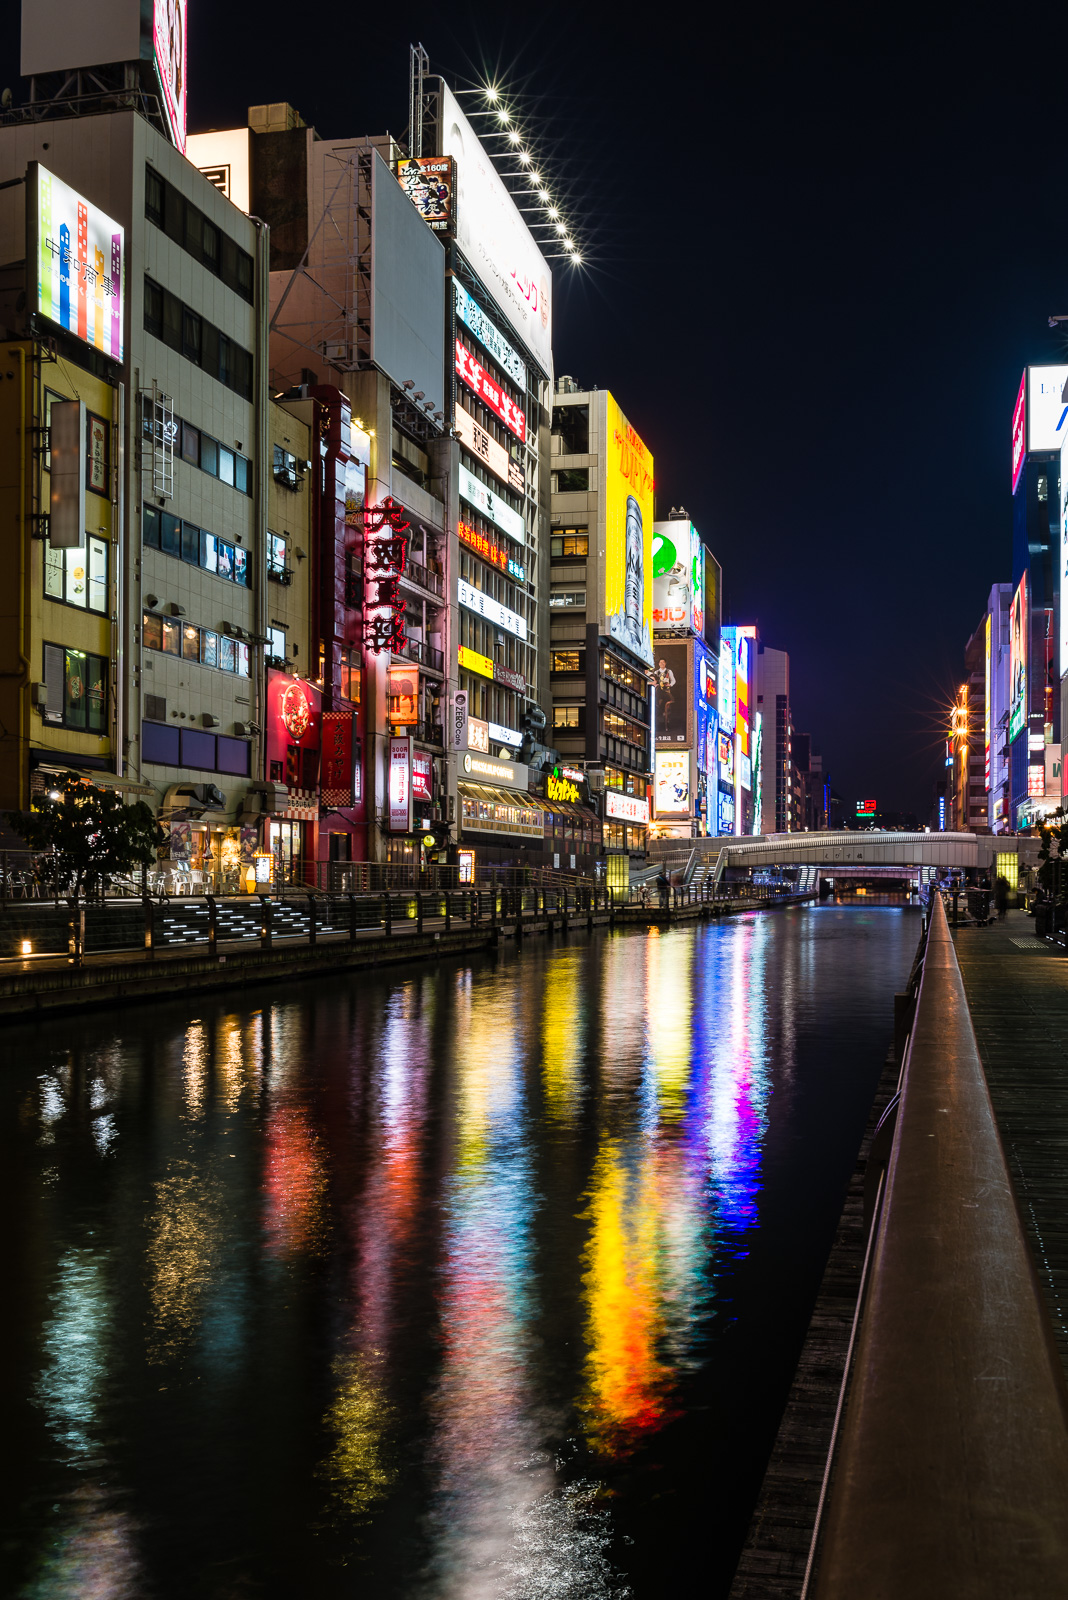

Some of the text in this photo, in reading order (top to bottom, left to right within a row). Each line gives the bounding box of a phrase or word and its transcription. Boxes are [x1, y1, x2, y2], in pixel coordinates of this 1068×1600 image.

[45, 237, 117, 298] 中和商事
[366, 496, 411, 657] 大阪王将
[455, 706, 464, 729] ZERO
[333, 721, 345, 781] 大阪みやげ
